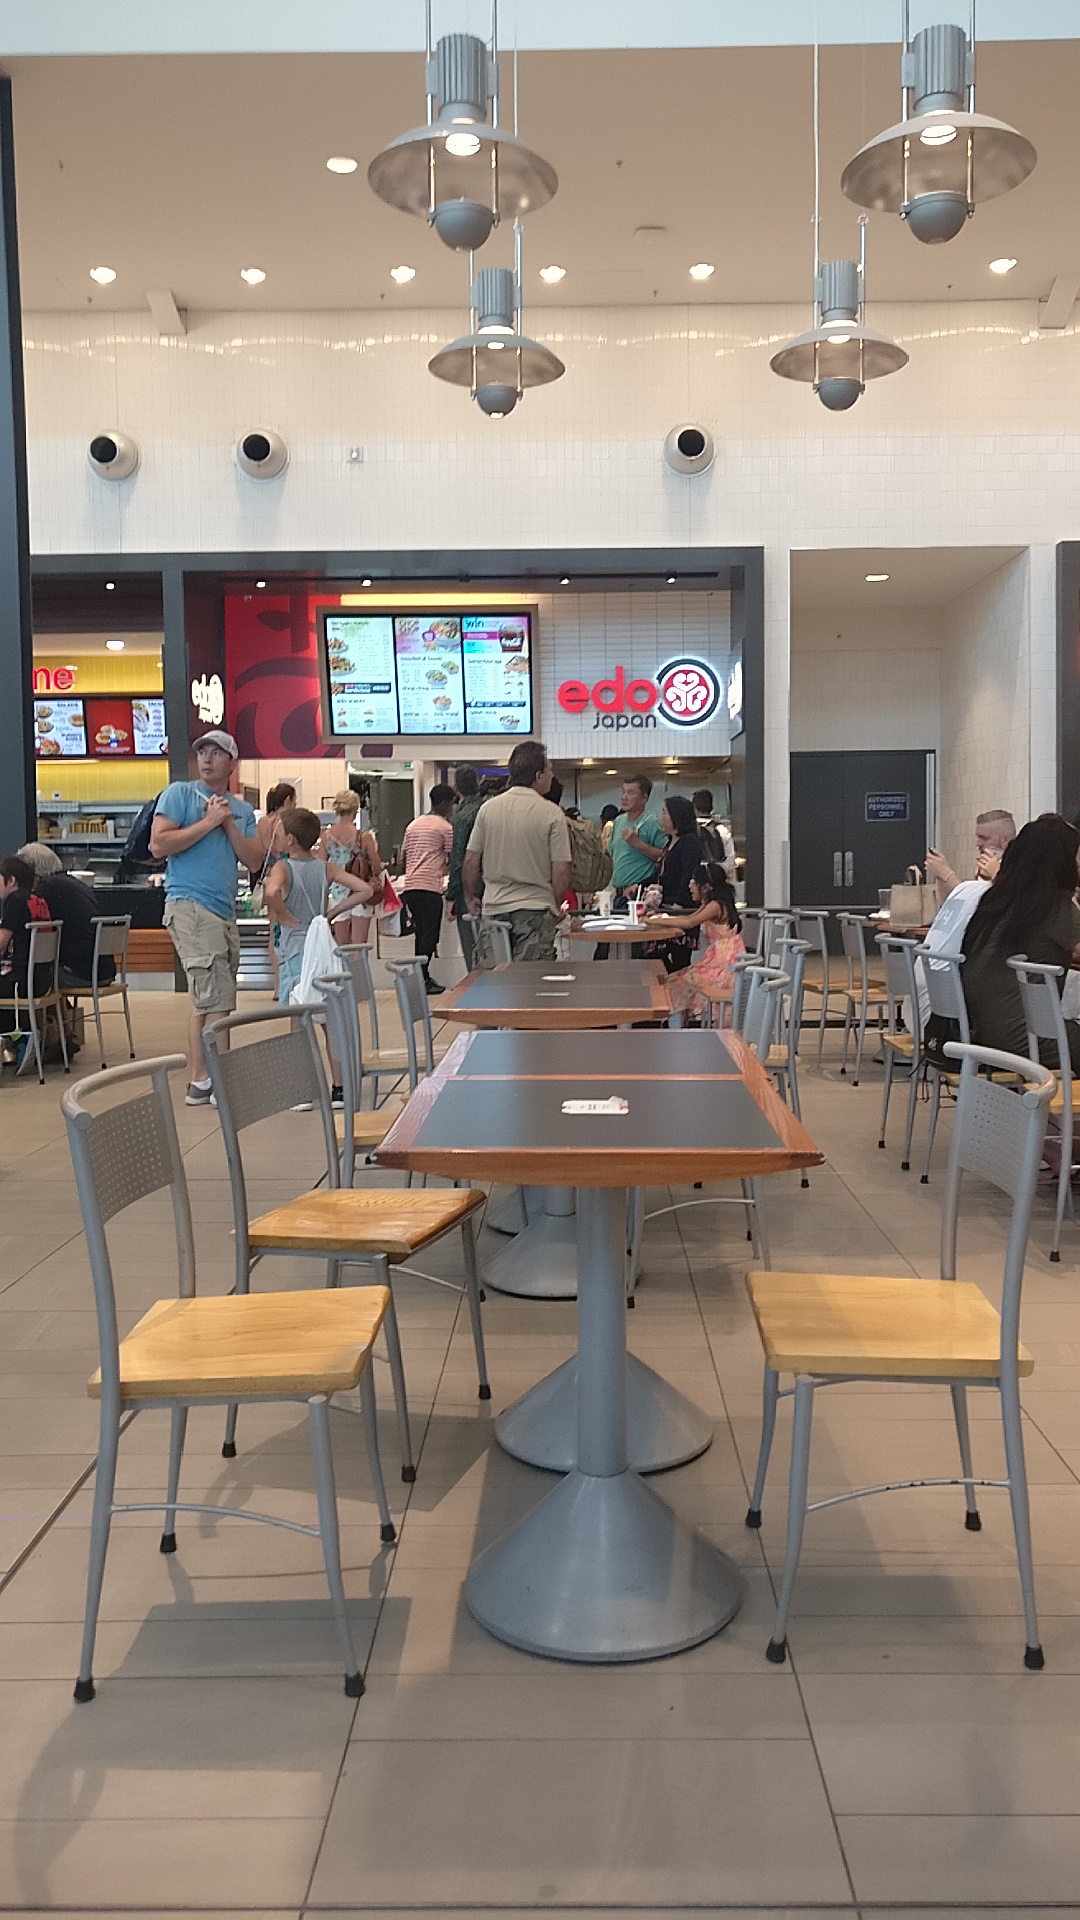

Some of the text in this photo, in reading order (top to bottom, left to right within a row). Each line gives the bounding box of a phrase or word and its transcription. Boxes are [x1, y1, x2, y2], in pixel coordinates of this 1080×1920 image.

[557, 665, 657, 713] edo
[592, 712, 657, 731] japan
[878, 810, 896, 818] ONLY
